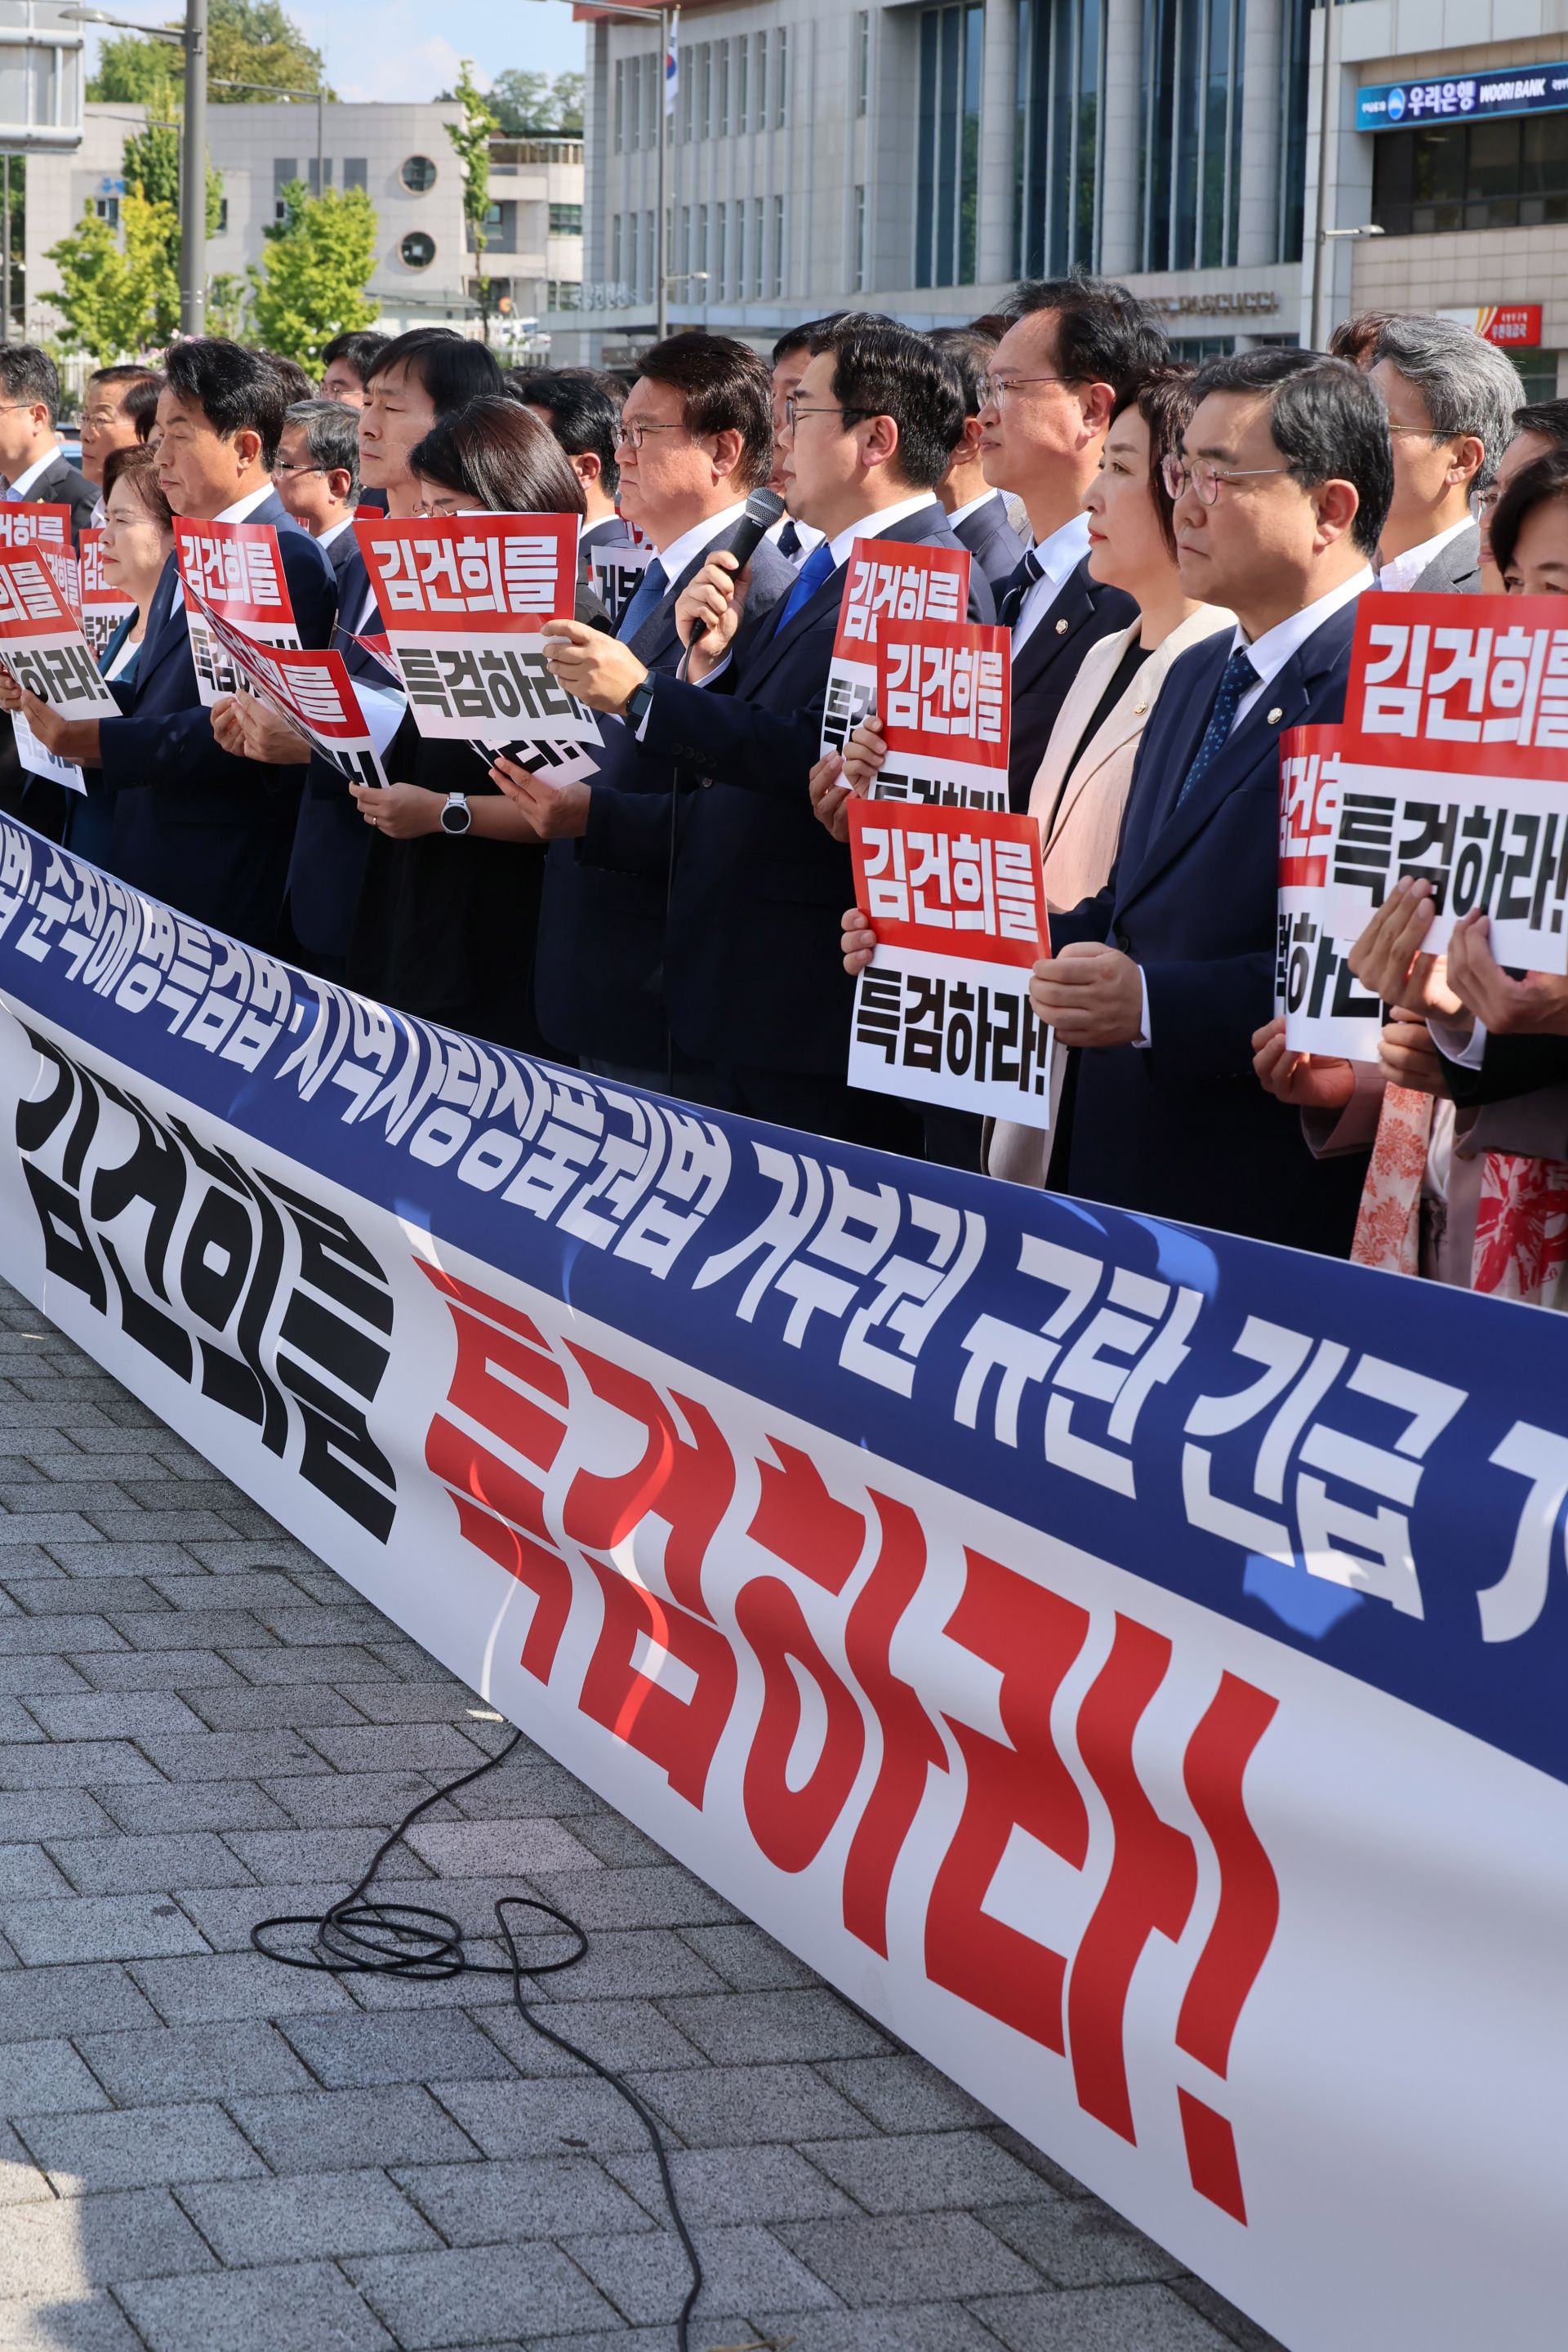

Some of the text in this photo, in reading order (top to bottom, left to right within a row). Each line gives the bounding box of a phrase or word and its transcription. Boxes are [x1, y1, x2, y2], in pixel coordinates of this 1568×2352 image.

[1408, 81, 1476, 116] 우리은행
[1480, 82, 1514, 103] WOORI
[1515, 78, 1547, 98] BANK
[1178, 292, 1281, 315] PASCUCCI
[180, 535, 282, 606] 김건희를
[370, 535, 558, 613] 김건희를
[886, 644, 1002, 742] 김건희를
[861, 826, 1039, 942] 김건희를
[1334, 791, 1568, 933] 특검하라!
[856, 967, 1049, 1096] 특검하라!
[692, 1141, 986, 1398] 거부권
[954, 1233, 1203, 1499] 규탄
[1182, 1315, 1468, 1621] 긴급
[16, 1018, 1281, 2227] 김건희를 특검하라!
